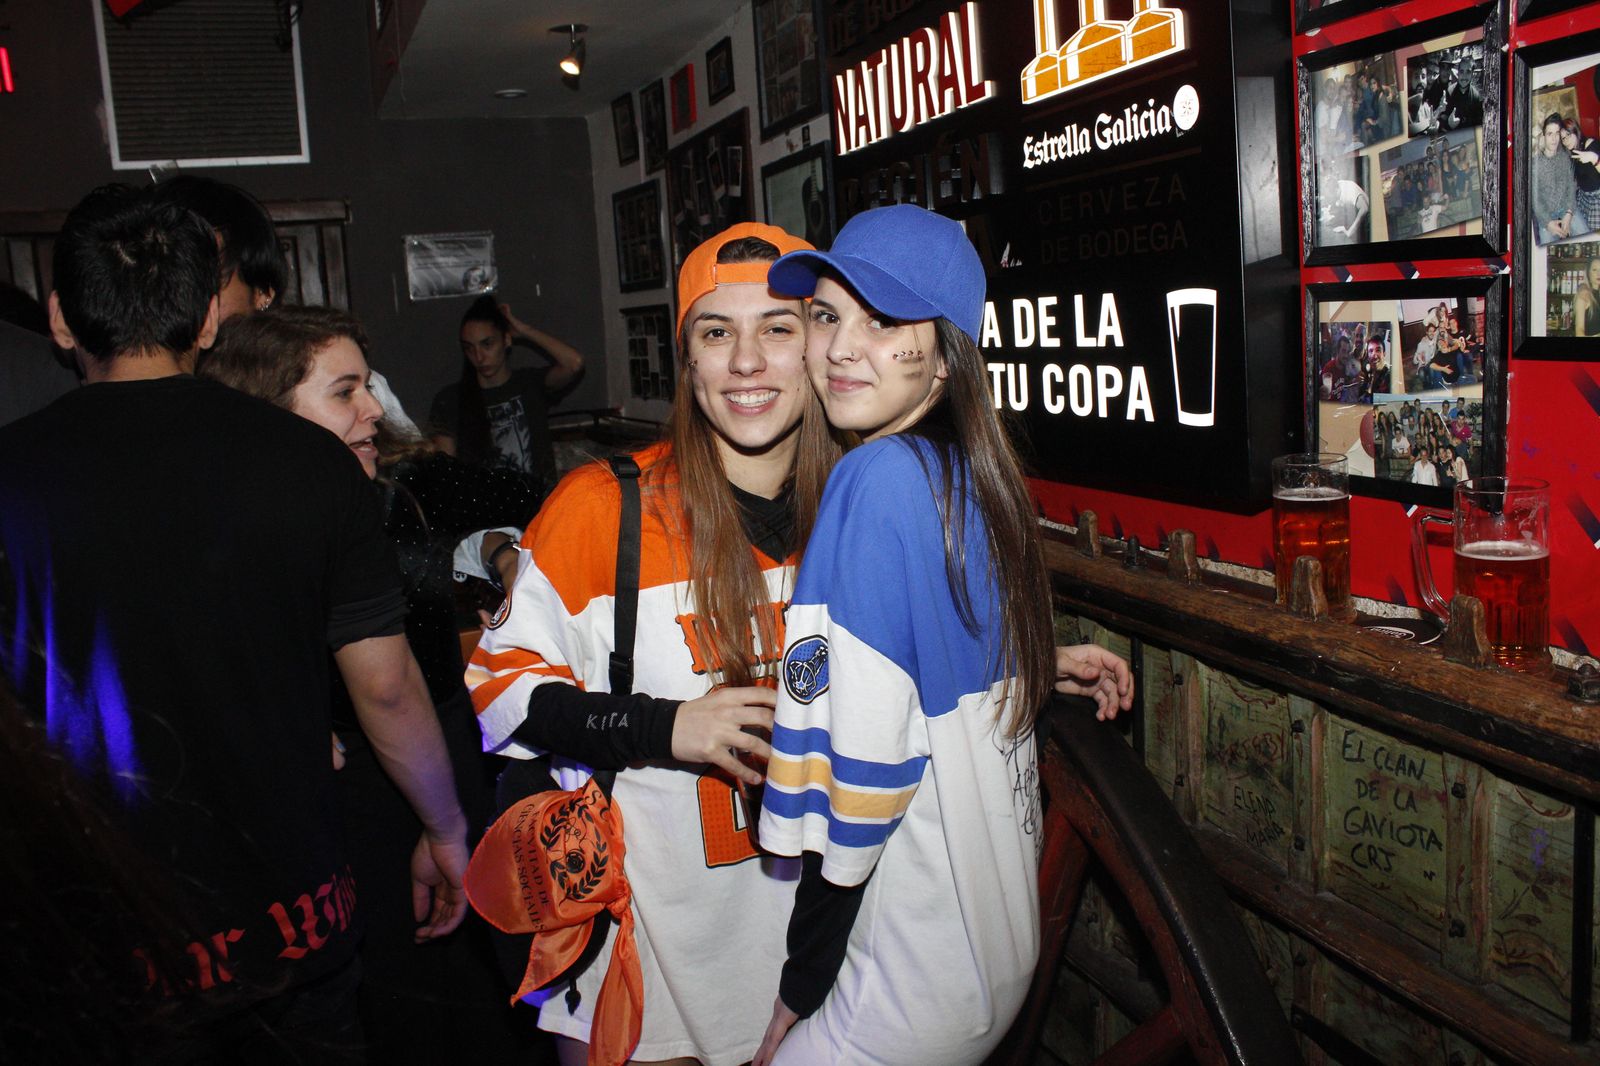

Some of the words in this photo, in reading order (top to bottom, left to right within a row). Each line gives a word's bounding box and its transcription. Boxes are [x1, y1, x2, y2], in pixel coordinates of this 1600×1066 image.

[832, 2, 992, 155] NATURAL
[1023, 123, 1091, 169] Estrella
[1095, 98, 1172, 150] Galicia
[1040, 173, 1186, 225] CERVEZA
[1040, 236, 1071, 265] DE
[1078, 218, 1188, 260] BODEGA
[1012, 296, 1061, 347] DE
[1074, 292, 1124, 347] LA
[987, 363, 1029, 411] TU
[1042, 363, 1155, 422] COPA
[1342, 730, 1365, 762] EL
[1374, 746, 1426, 781] CLAN
[1355, 778, 1380, 801] DE
[1393, 787, 1418, 813] LA
